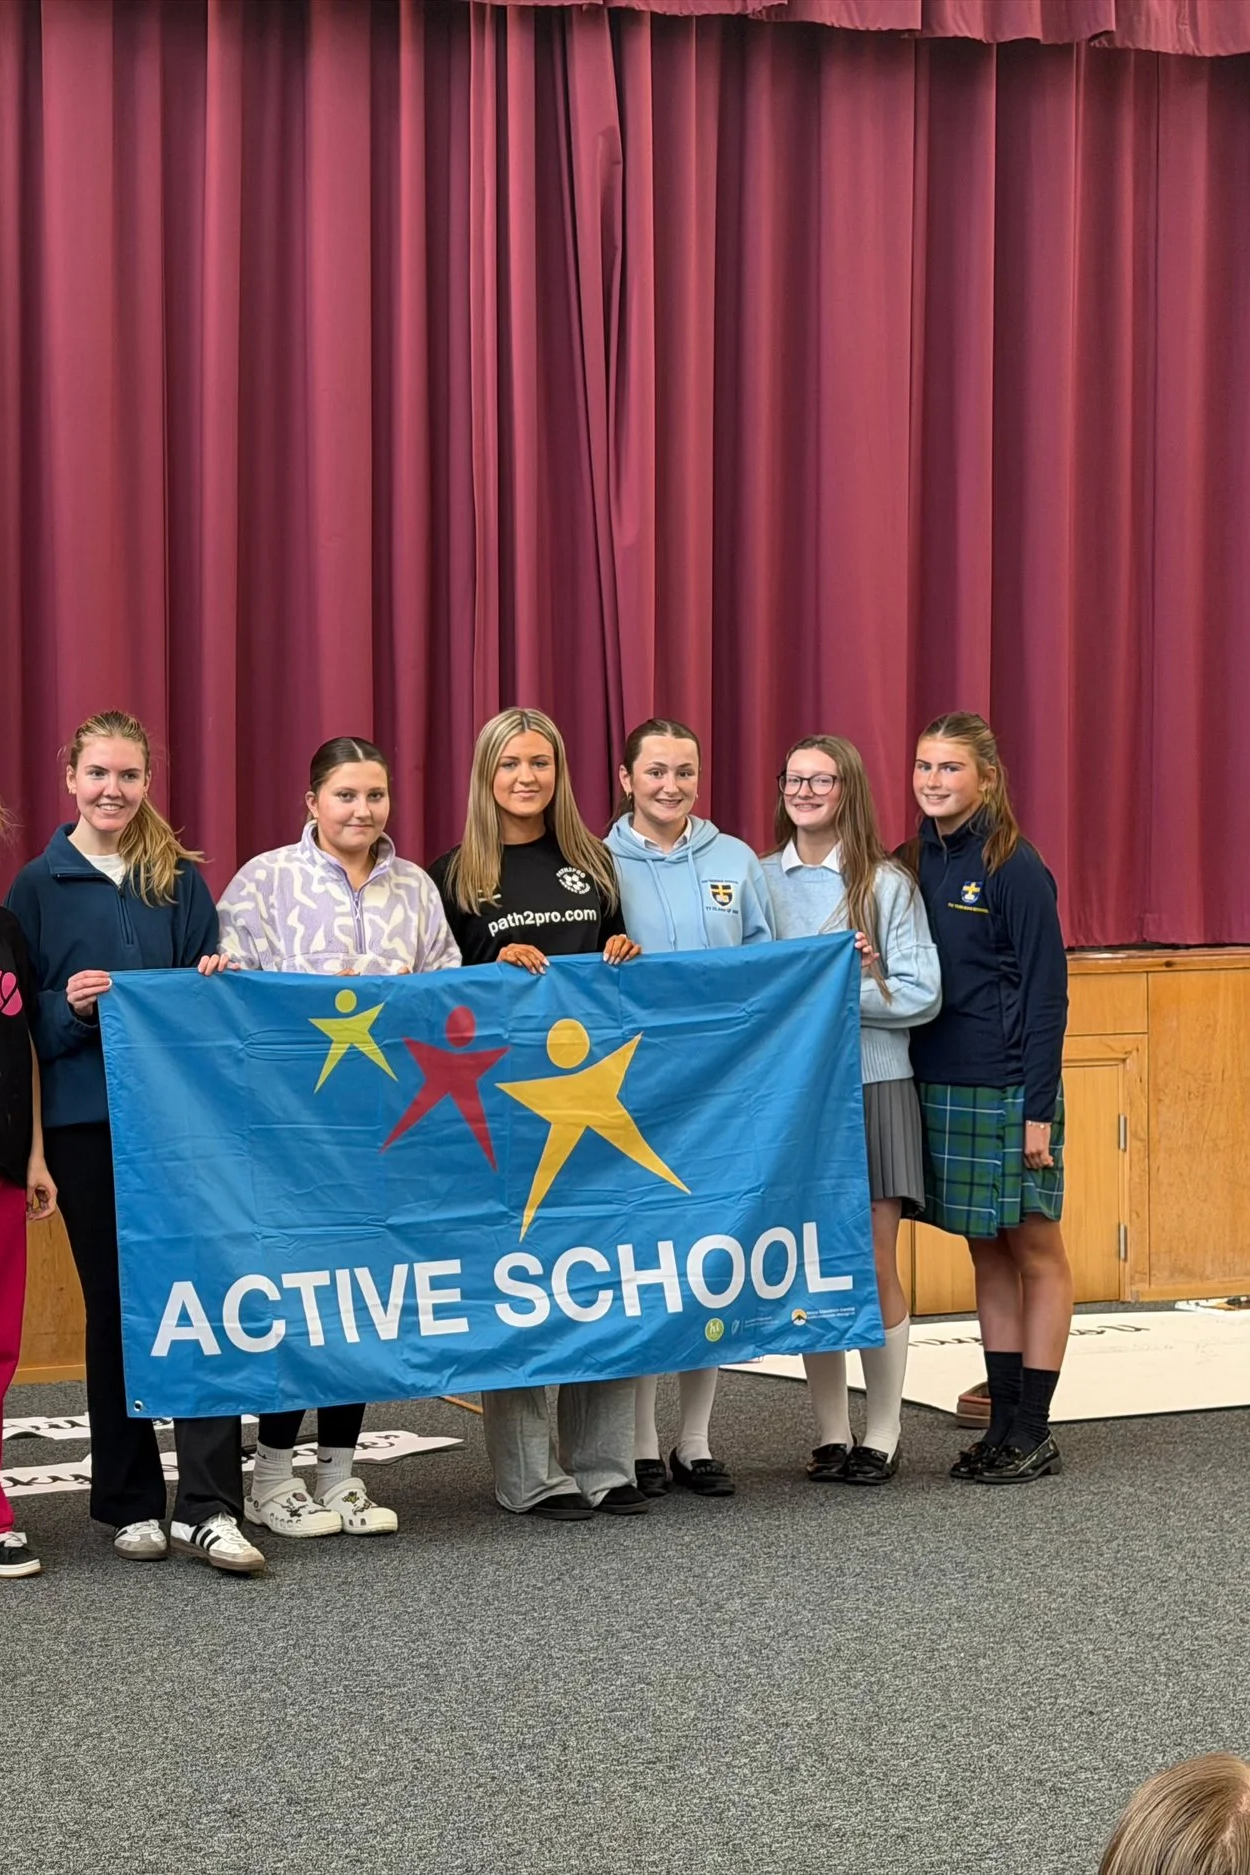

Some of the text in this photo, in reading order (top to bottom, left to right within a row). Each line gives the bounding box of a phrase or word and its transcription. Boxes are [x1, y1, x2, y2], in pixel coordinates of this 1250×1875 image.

[488, 908, 597, 937] path2pro.com
[151, 1221, 854, 1357] ACTIVE SCHOOL
